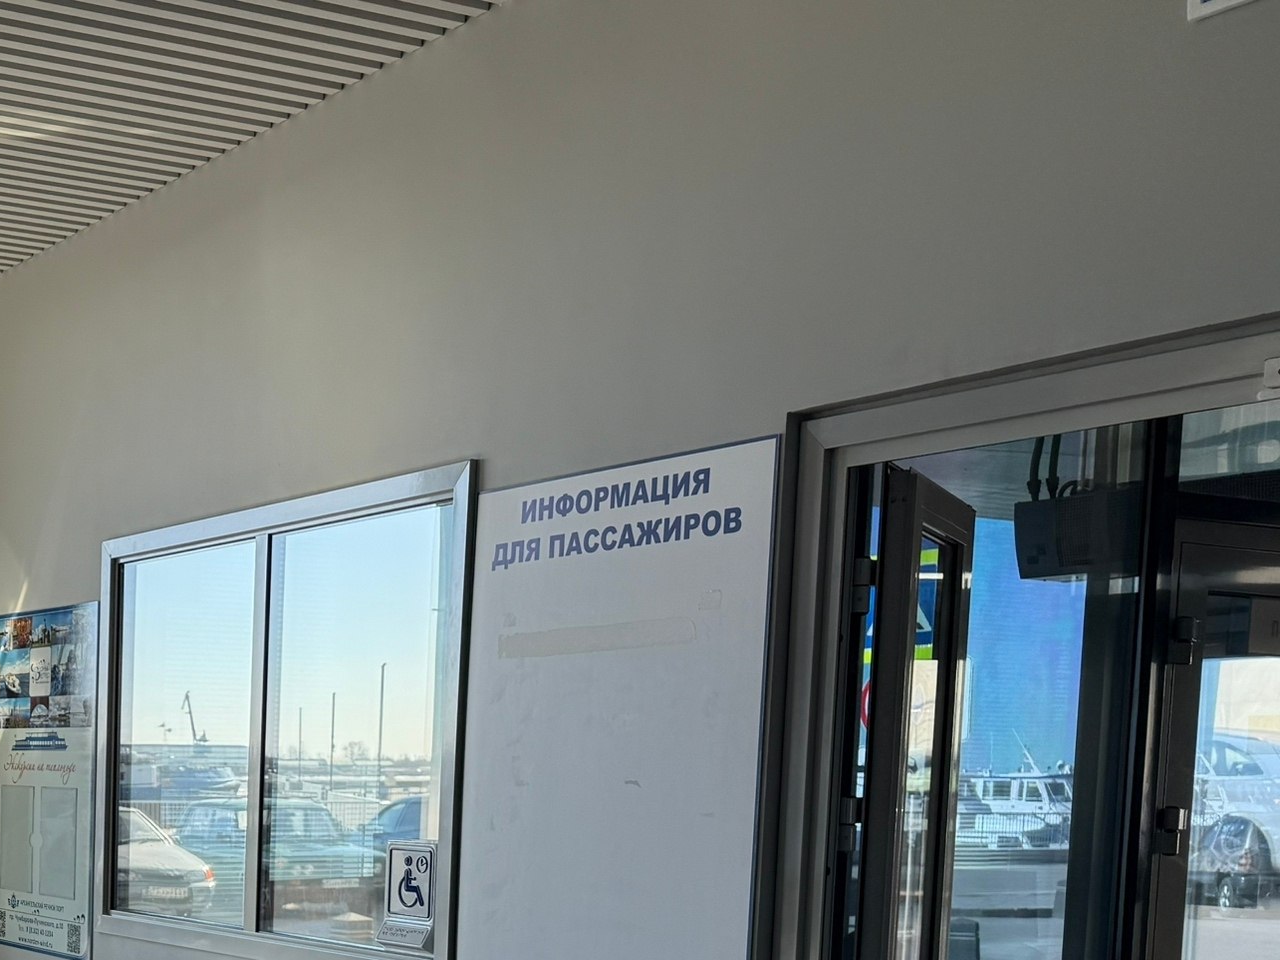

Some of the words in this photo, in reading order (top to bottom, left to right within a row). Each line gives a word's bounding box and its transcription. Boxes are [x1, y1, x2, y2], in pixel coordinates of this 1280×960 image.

[521, 467, 711, 525] ИНФОРМАЦИЯ
[491, 538, 541, 572] ДЛЯ
[548, 507, 743, 558] ПАССАЖИРОВ
